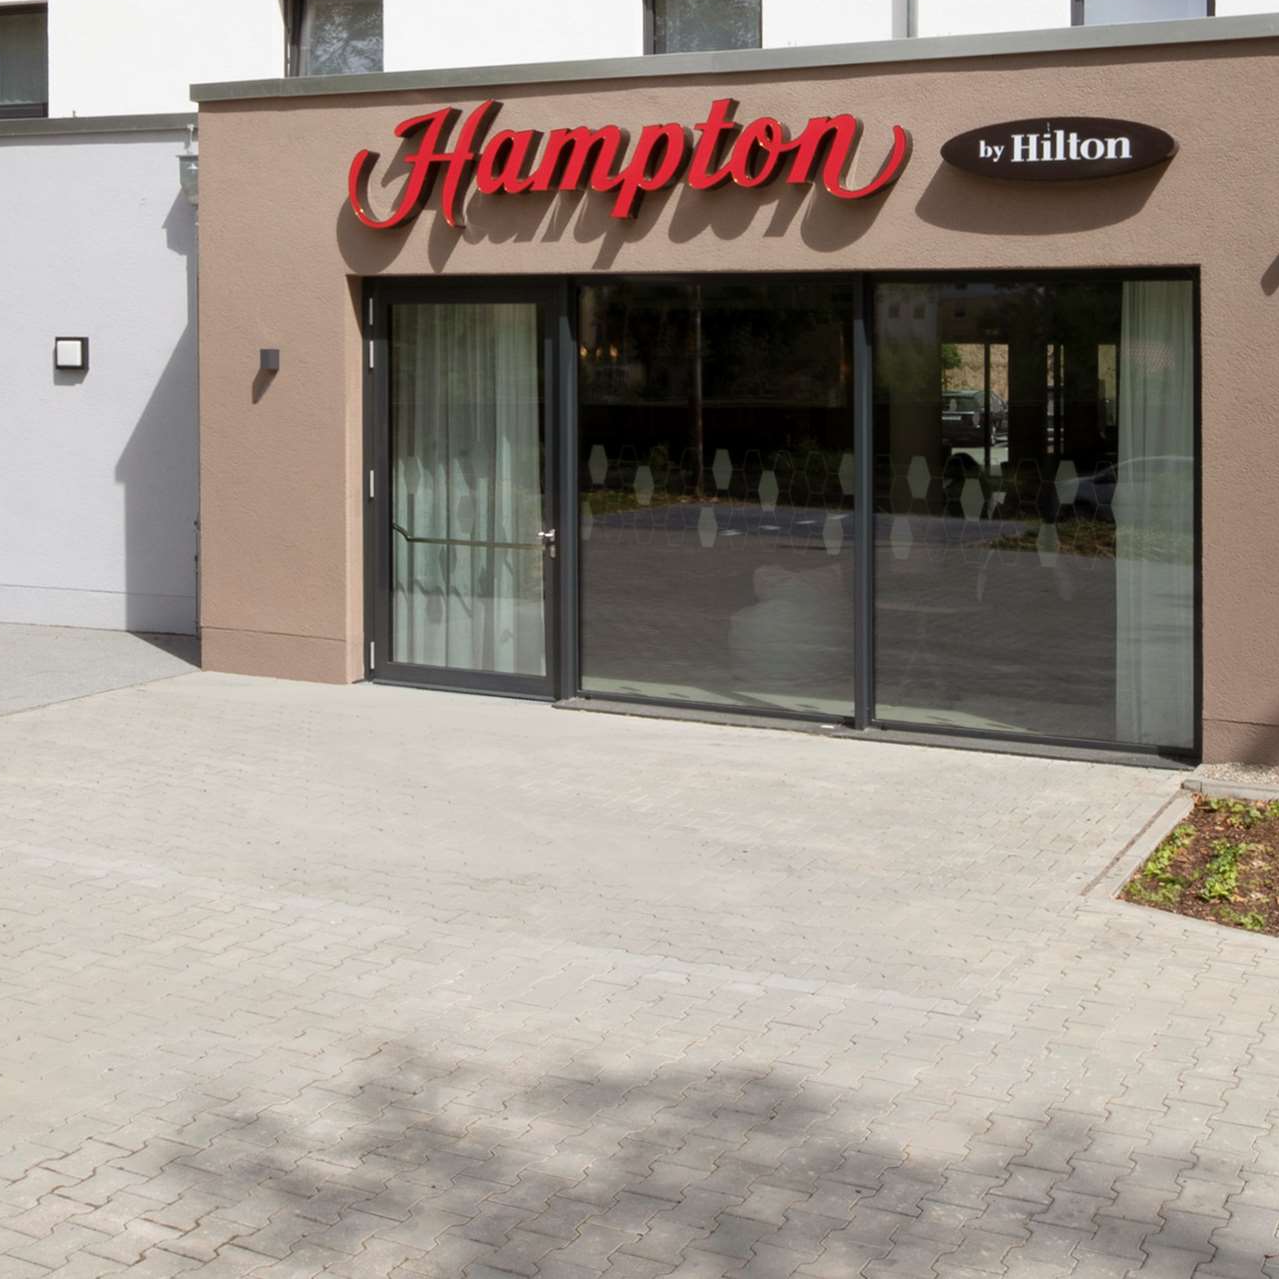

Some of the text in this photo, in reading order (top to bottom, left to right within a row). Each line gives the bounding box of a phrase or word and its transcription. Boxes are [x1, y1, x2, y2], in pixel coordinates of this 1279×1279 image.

[347, 98, 908, 229] Hampton
[979, 129, 1133, 163] by Hilton
